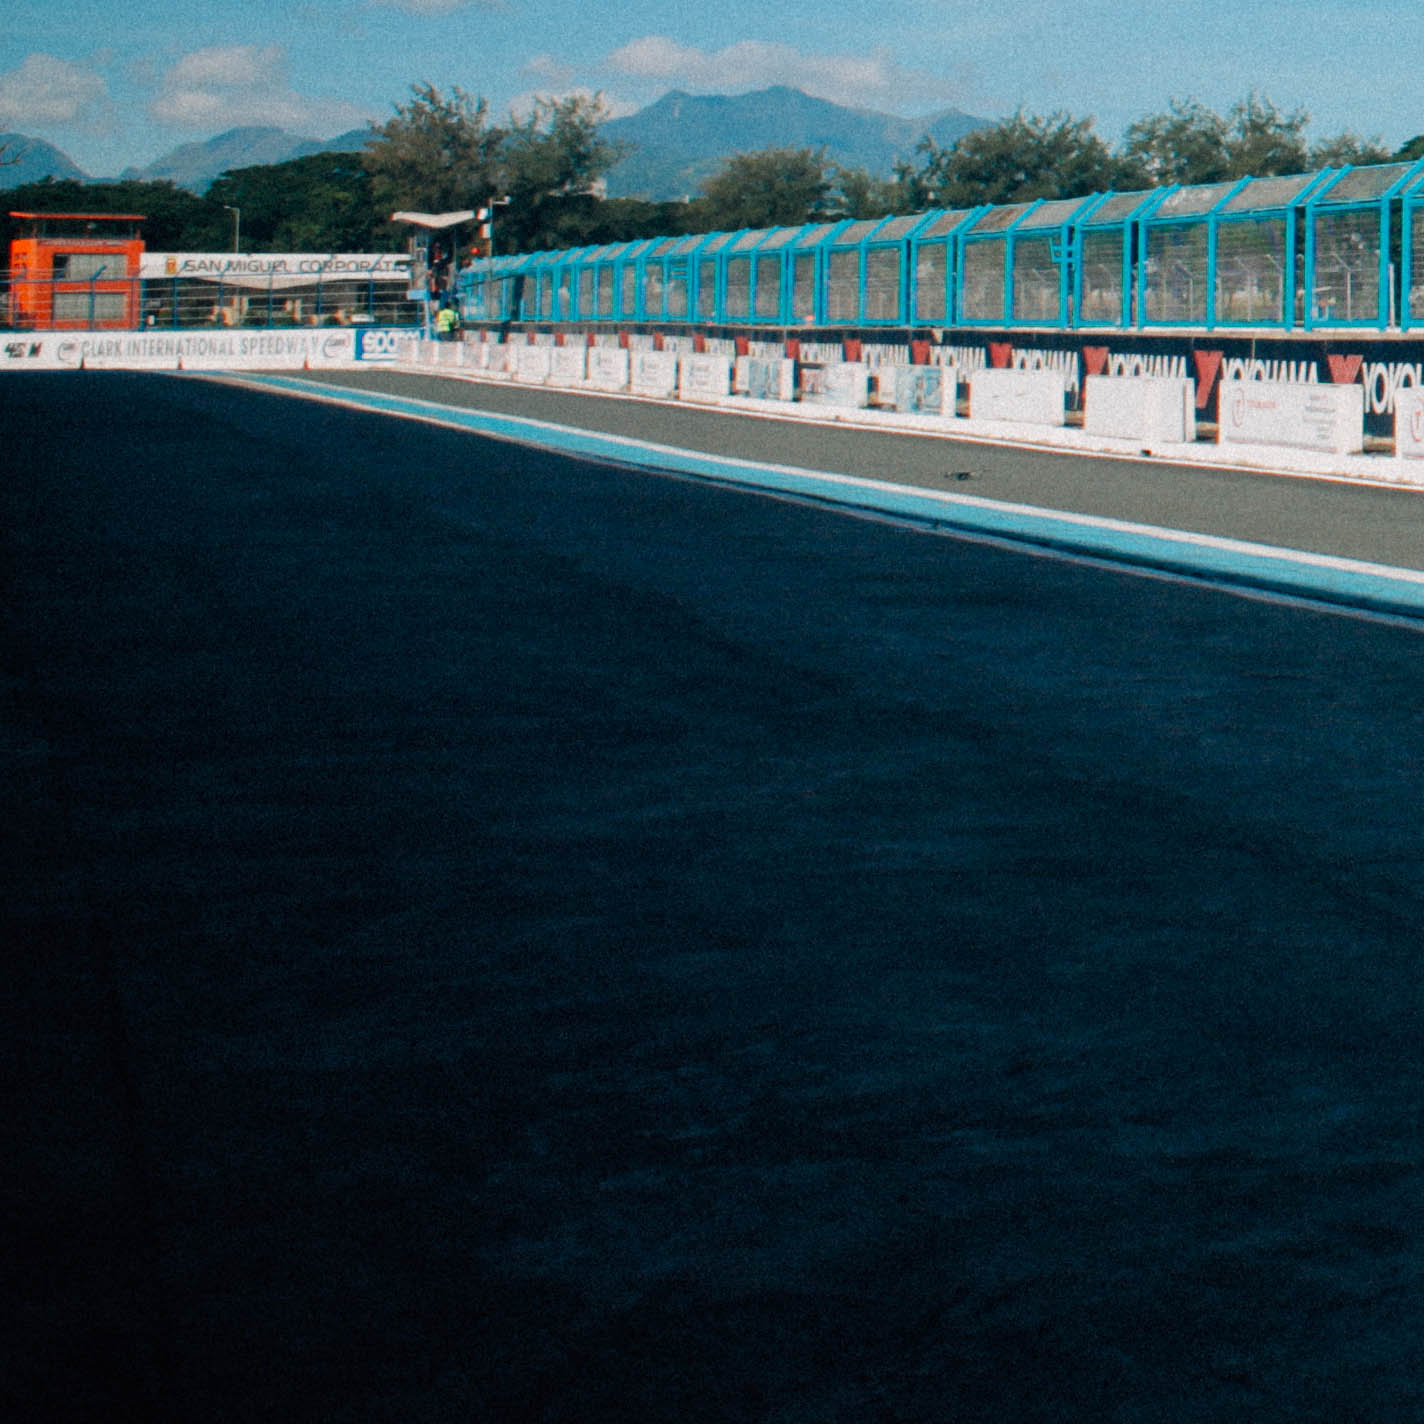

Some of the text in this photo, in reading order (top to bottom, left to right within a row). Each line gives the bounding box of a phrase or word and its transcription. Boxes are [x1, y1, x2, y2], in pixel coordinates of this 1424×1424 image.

[184, 259, 221, 273] SAN
[226, 259, 289, 273] MIGUEL
[126, 337, 234, 357] INTERNATIONAL
